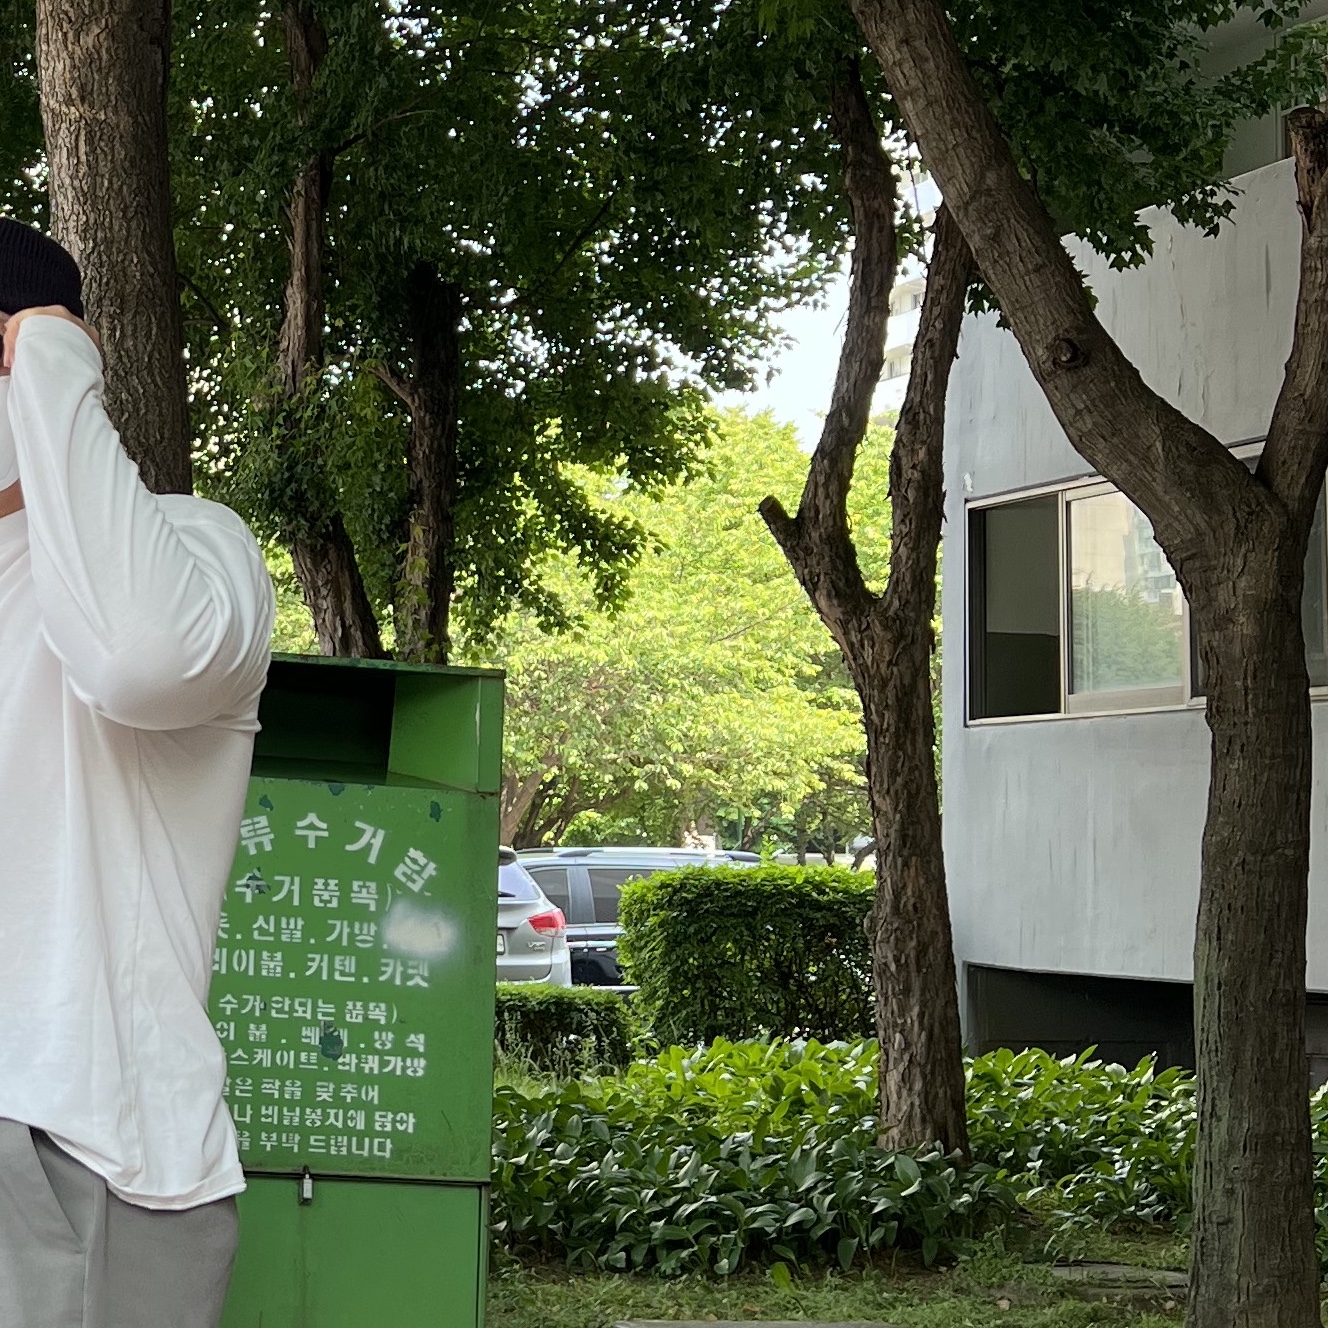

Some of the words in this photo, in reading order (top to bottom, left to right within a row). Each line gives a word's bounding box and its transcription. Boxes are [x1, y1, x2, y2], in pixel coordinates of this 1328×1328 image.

[223, 868, 392, 912] 수거품목)
[270, 995, 336, 1021] 안되는
[260, 1105, 366, 1131] 비닐봉지에
[307, 1135, 393, 1159] 드립니다
